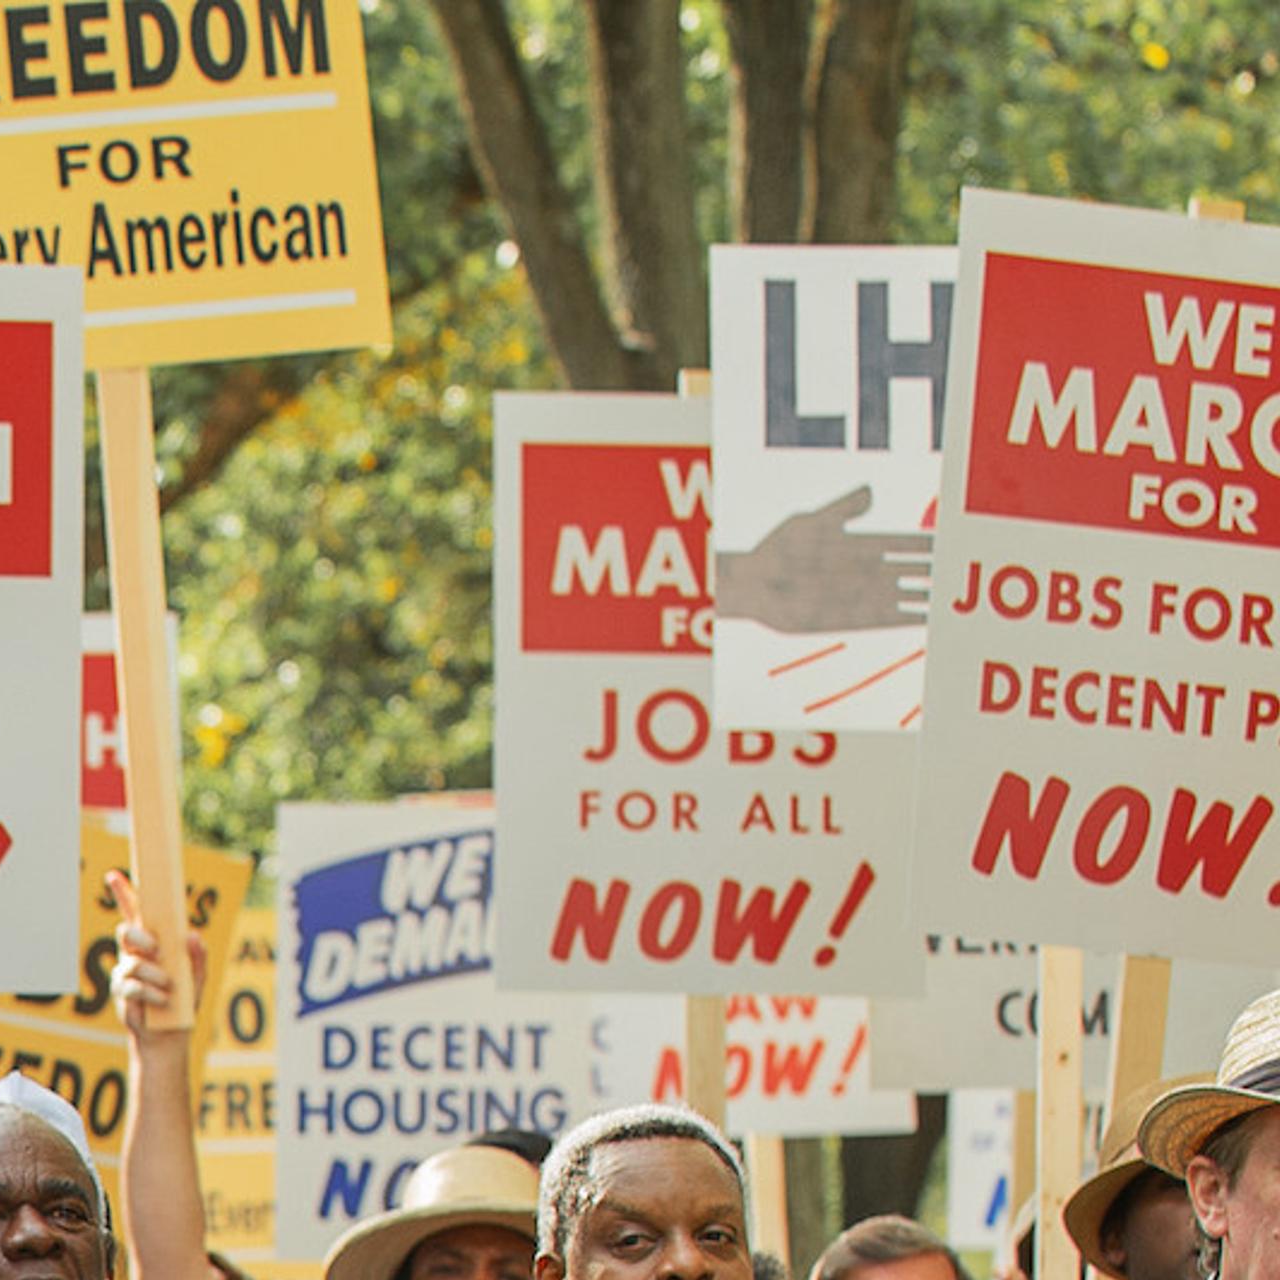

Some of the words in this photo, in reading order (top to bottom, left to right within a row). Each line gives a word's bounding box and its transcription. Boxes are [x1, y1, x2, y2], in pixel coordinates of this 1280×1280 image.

[57, 136, 191, 188] FOR
[87, 189, 348, 278] American
[1144, 290, 1276, 378] WE
[659, 460, 713, 519] W
[1129, 472, 1258, 534] FOR
[551, 525, 715, 598] MA
[661, 607, 715, 648] FO
[952, 561, 1124, 629] JOBS
[1149, 583, 1274, 647] FOR
[980, 660, 1227, 737] DECENT
[578, 790, 700, 834] FOR
[741, 793, 844, 835] ALL
[378, 834, 492, 914] WE
[549, 859, 876, 969] NOW!
[300, 900, 494, 1004] DEMA
[321, 1023, 553, 1071] DECENT
[297, 1087, 569, 1135] HOUSING
